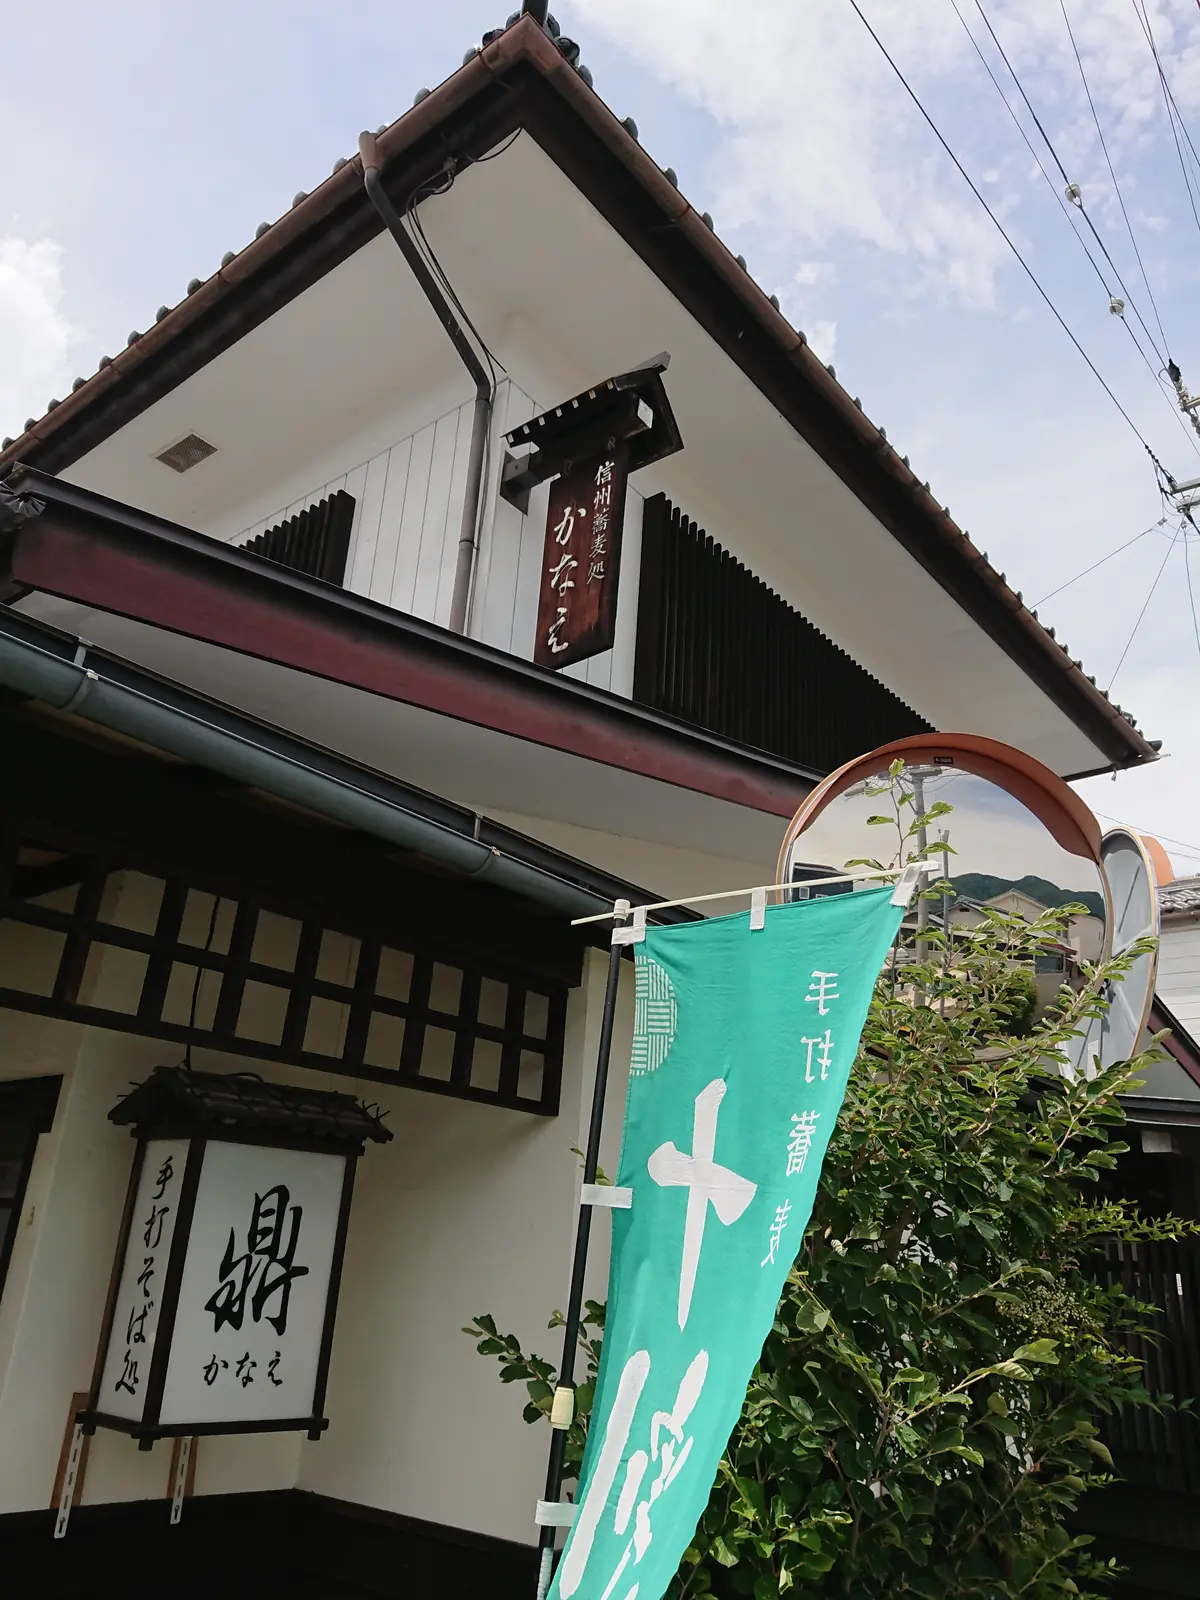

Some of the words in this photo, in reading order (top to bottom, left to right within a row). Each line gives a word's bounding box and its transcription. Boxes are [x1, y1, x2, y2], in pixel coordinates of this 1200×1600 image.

[548, 506, 586, 653] かなえ
[586, 460, 615, 584] 信州蕎麦処
[204, 1183, 309, 1337] 鼎
[202, 1350, 284, 1388] かなえ
